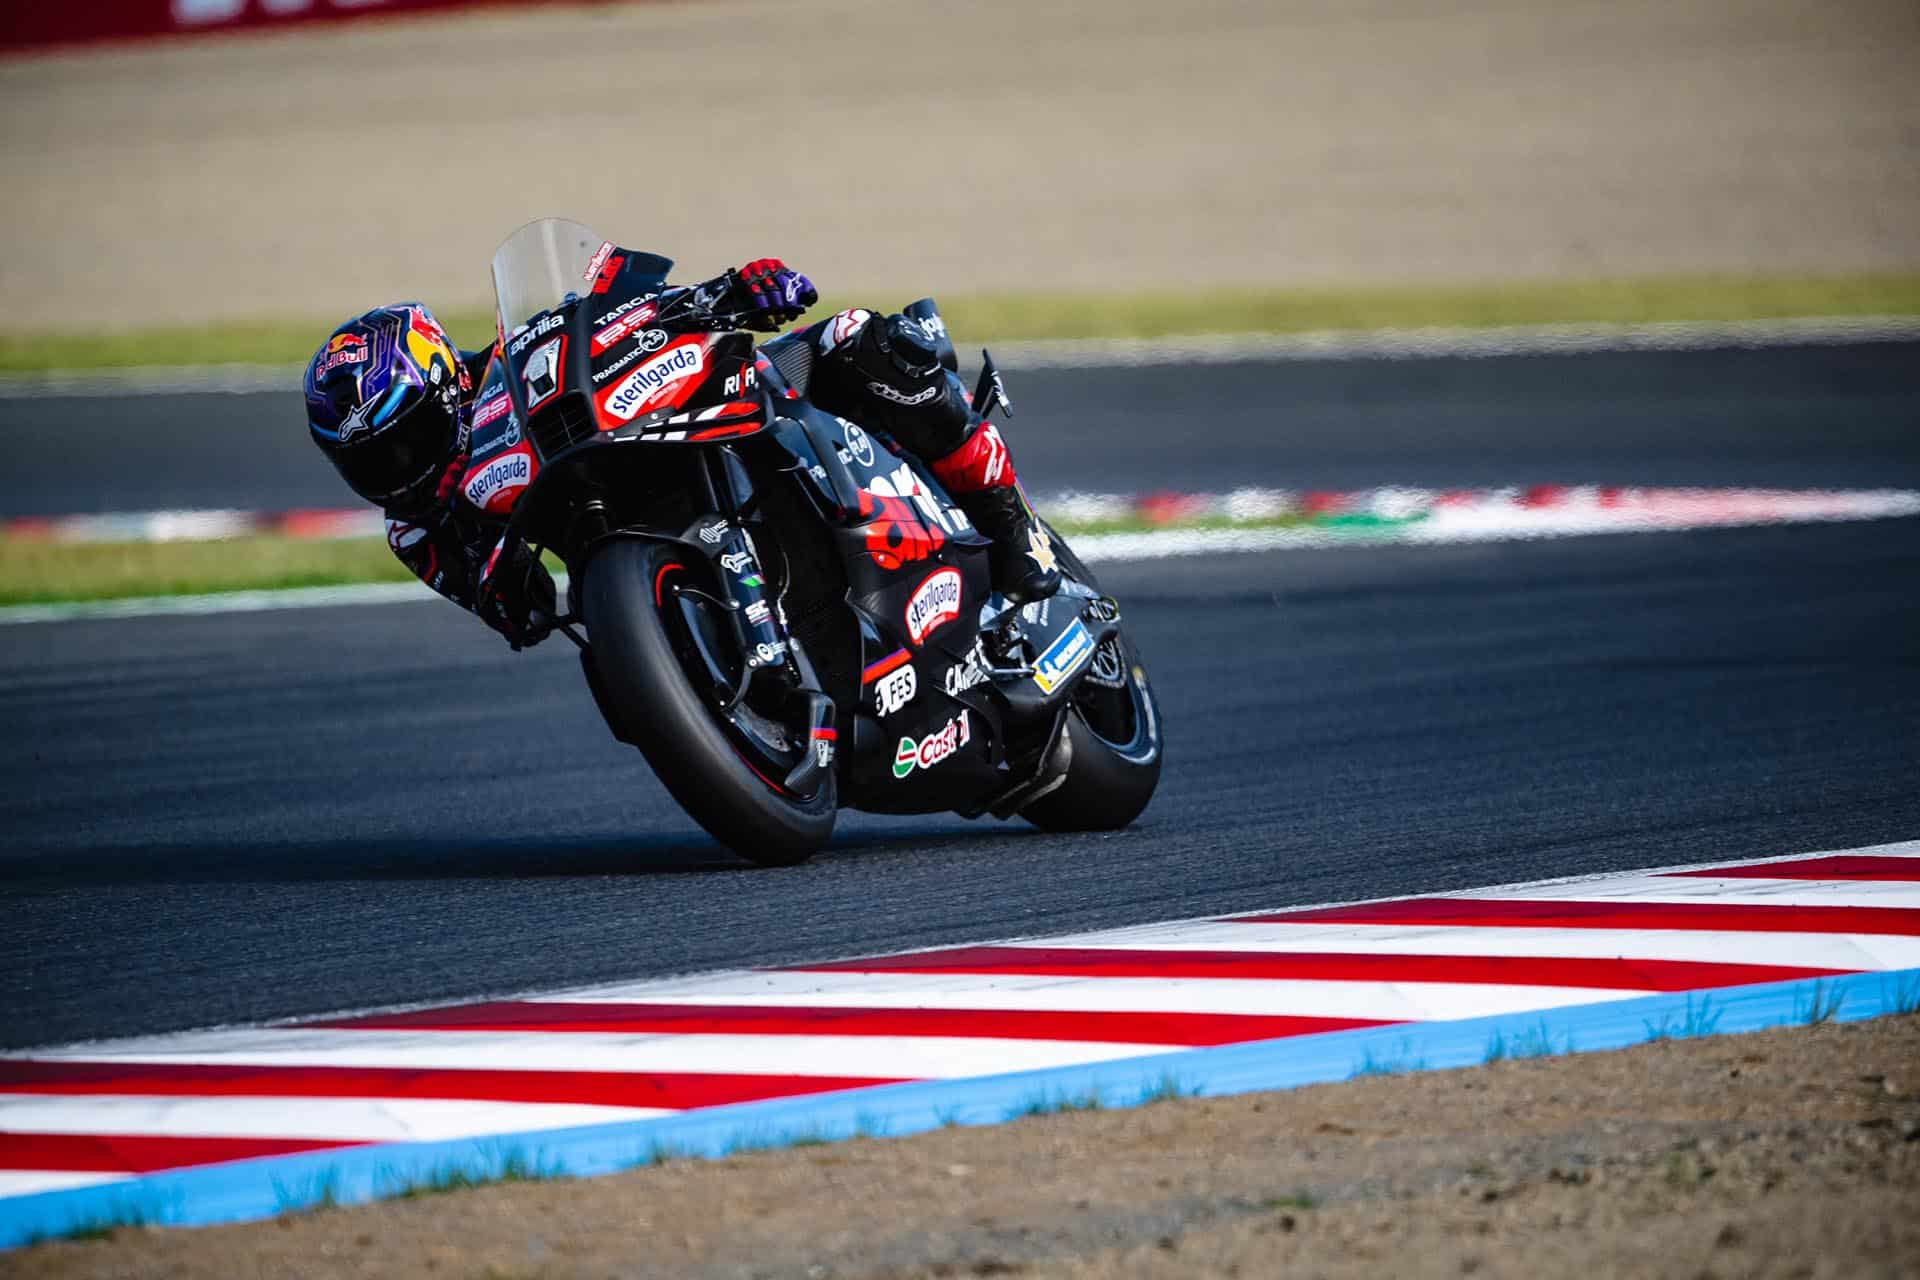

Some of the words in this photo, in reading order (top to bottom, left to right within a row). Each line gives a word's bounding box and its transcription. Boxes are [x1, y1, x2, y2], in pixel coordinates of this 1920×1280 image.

[594, 293, 659, 325] TARGA
[510, 315, 565, 356] aprilia
[316, 352, 336, 381] Rd
[612, 349, 697, 414] sterilgarda
[468, 456, 527, 503] sterilgarda
[911, 575, 957, 630] sterilgarda
